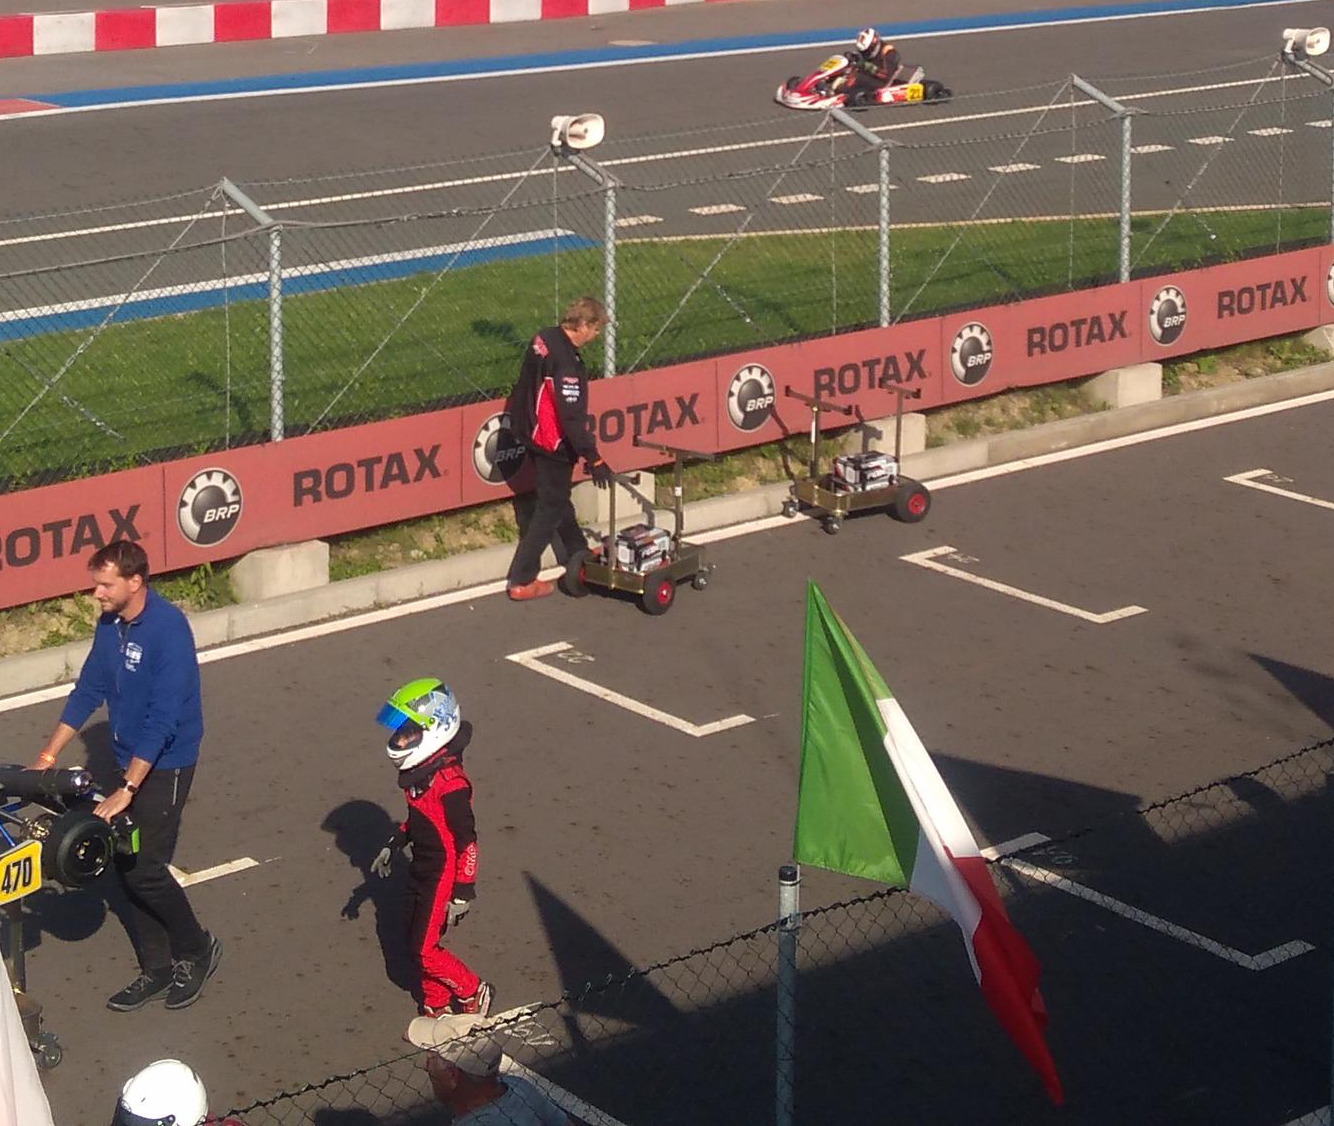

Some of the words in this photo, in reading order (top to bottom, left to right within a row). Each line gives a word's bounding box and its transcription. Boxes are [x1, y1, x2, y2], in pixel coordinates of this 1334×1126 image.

[1217, 276, 1308, 319] ROTAX
[1027, 311, 1128, 356] ROTAX
[1164, 314, 1187, 327] BRP
[968, 351, 992, 367] BRP
[814, 349, 927, 400] ROTAX
[746, 394, 775, 411] BRP
[495, 446, 525, 463] BRP
[293, 444, 441, 507] ROTAX
[204, 503, 240, 523] BRP
[1, 857, 33, 894] 470
